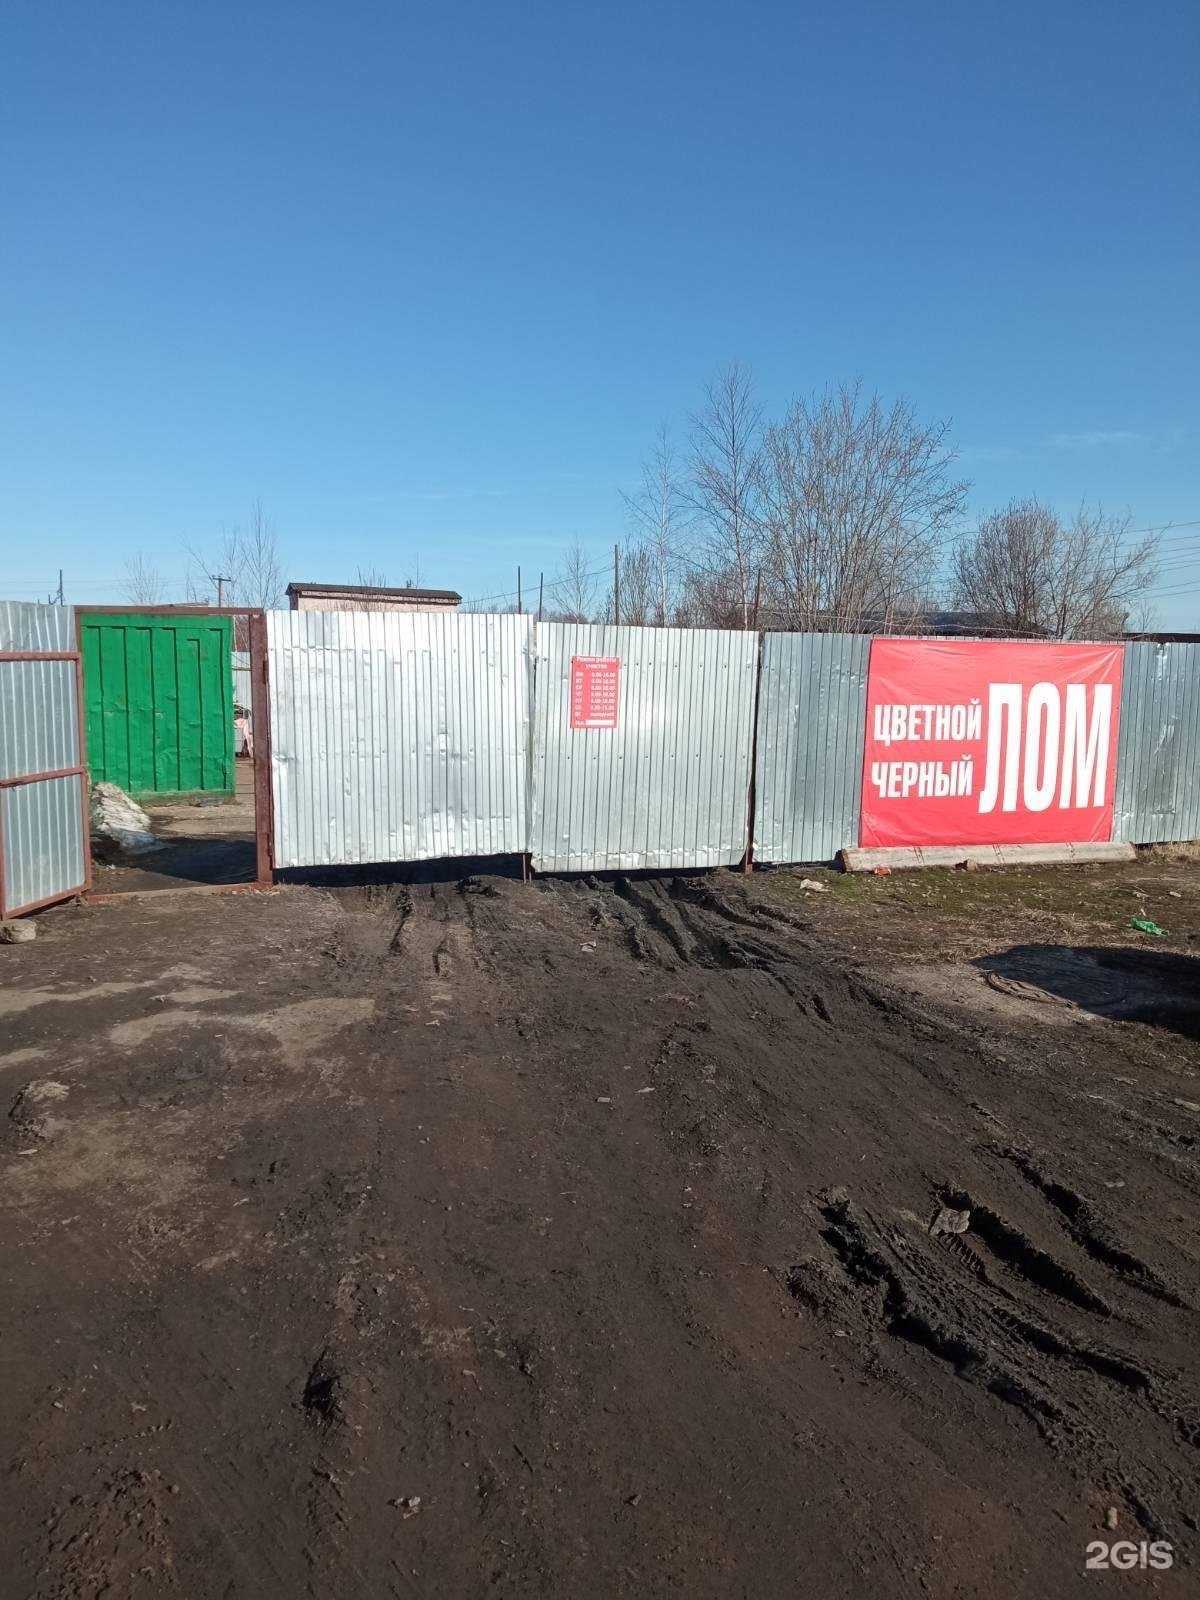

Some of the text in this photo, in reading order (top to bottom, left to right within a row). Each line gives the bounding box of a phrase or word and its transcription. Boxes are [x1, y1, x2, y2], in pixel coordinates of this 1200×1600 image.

[873, 697, 983, 747] ЦВЕТНОЙ
[977, 681, 1113, 814] ЛОМ
[871, 753, 974, 798] ЧЕРНЫЙ
